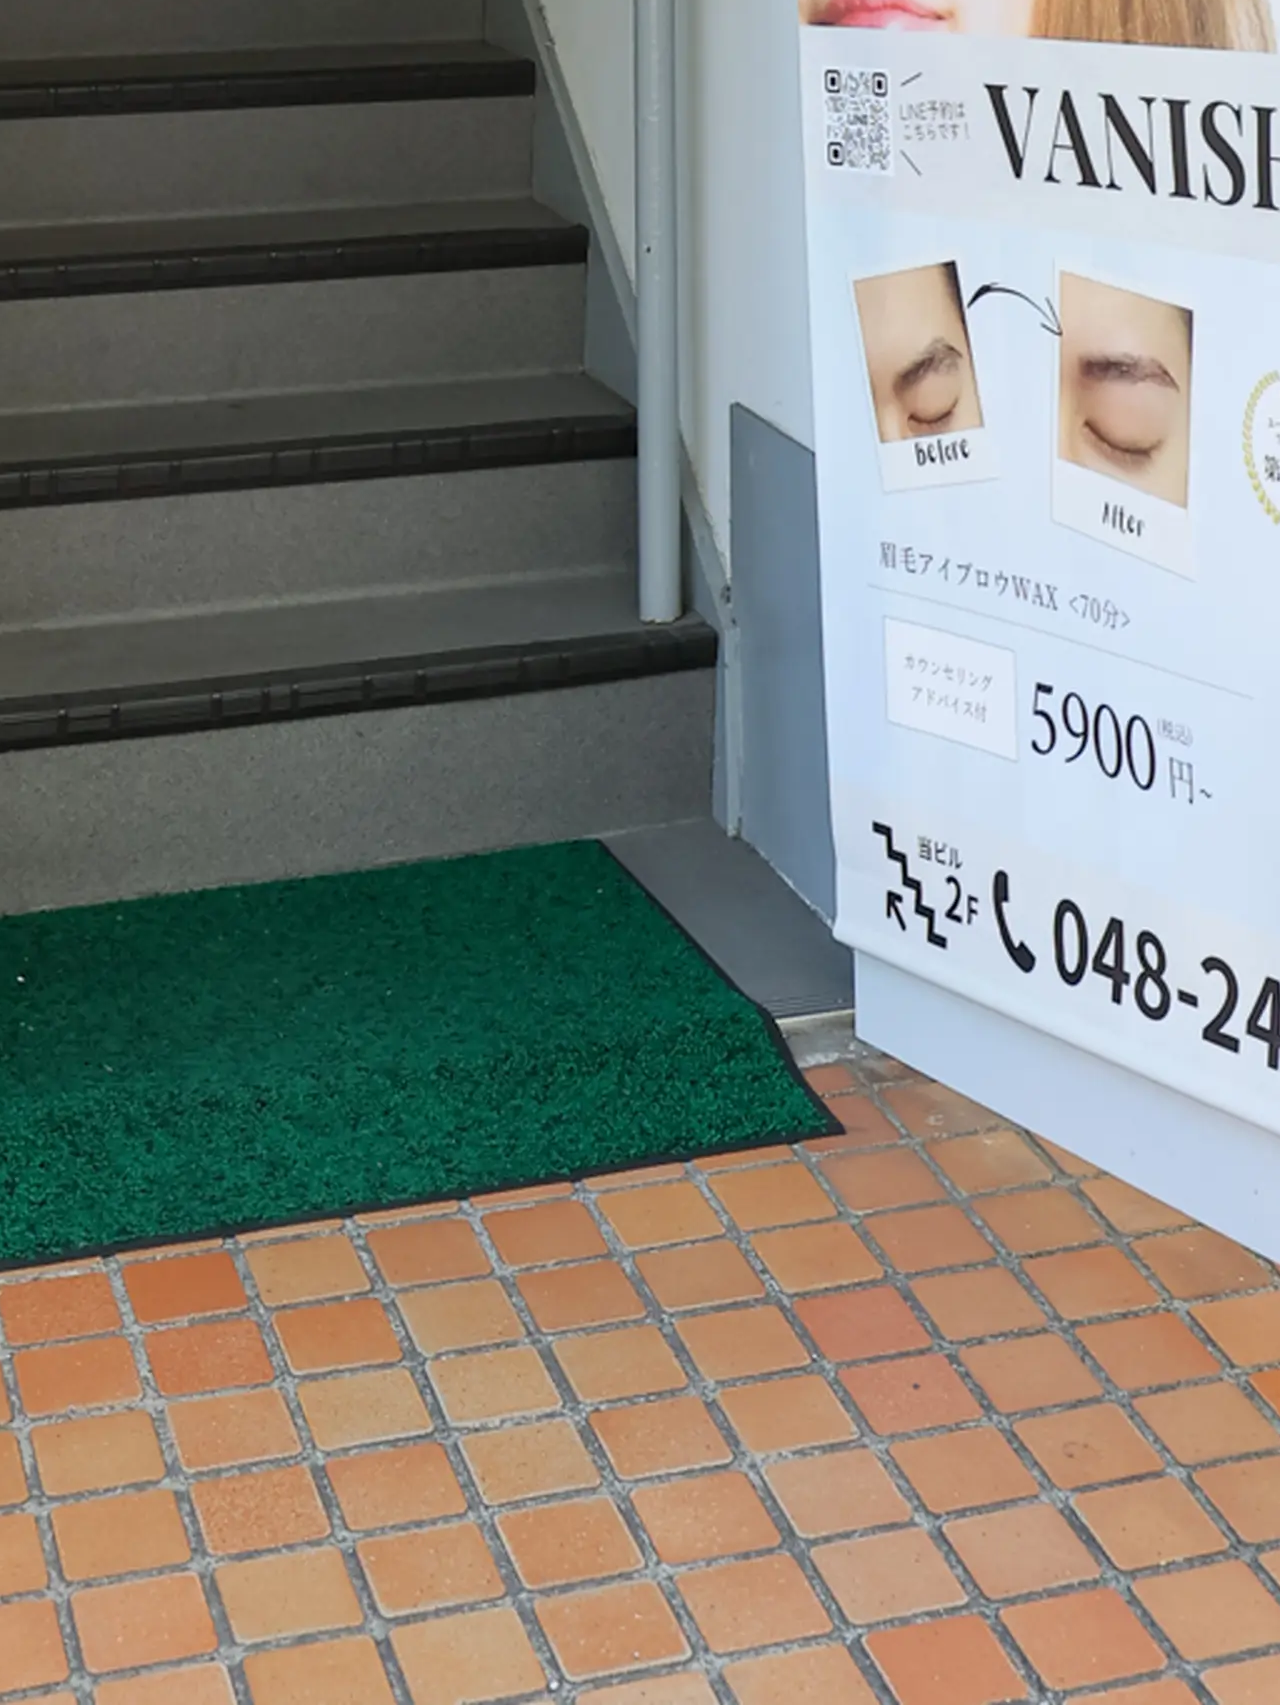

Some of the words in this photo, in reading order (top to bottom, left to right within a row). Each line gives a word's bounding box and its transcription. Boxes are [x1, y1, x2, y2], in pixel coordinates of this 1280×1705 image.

[1031, 682, 1157, 791] 5900
[918, 835, 963, 869] 当ビル
[945, 874, 979, 925] 2F
